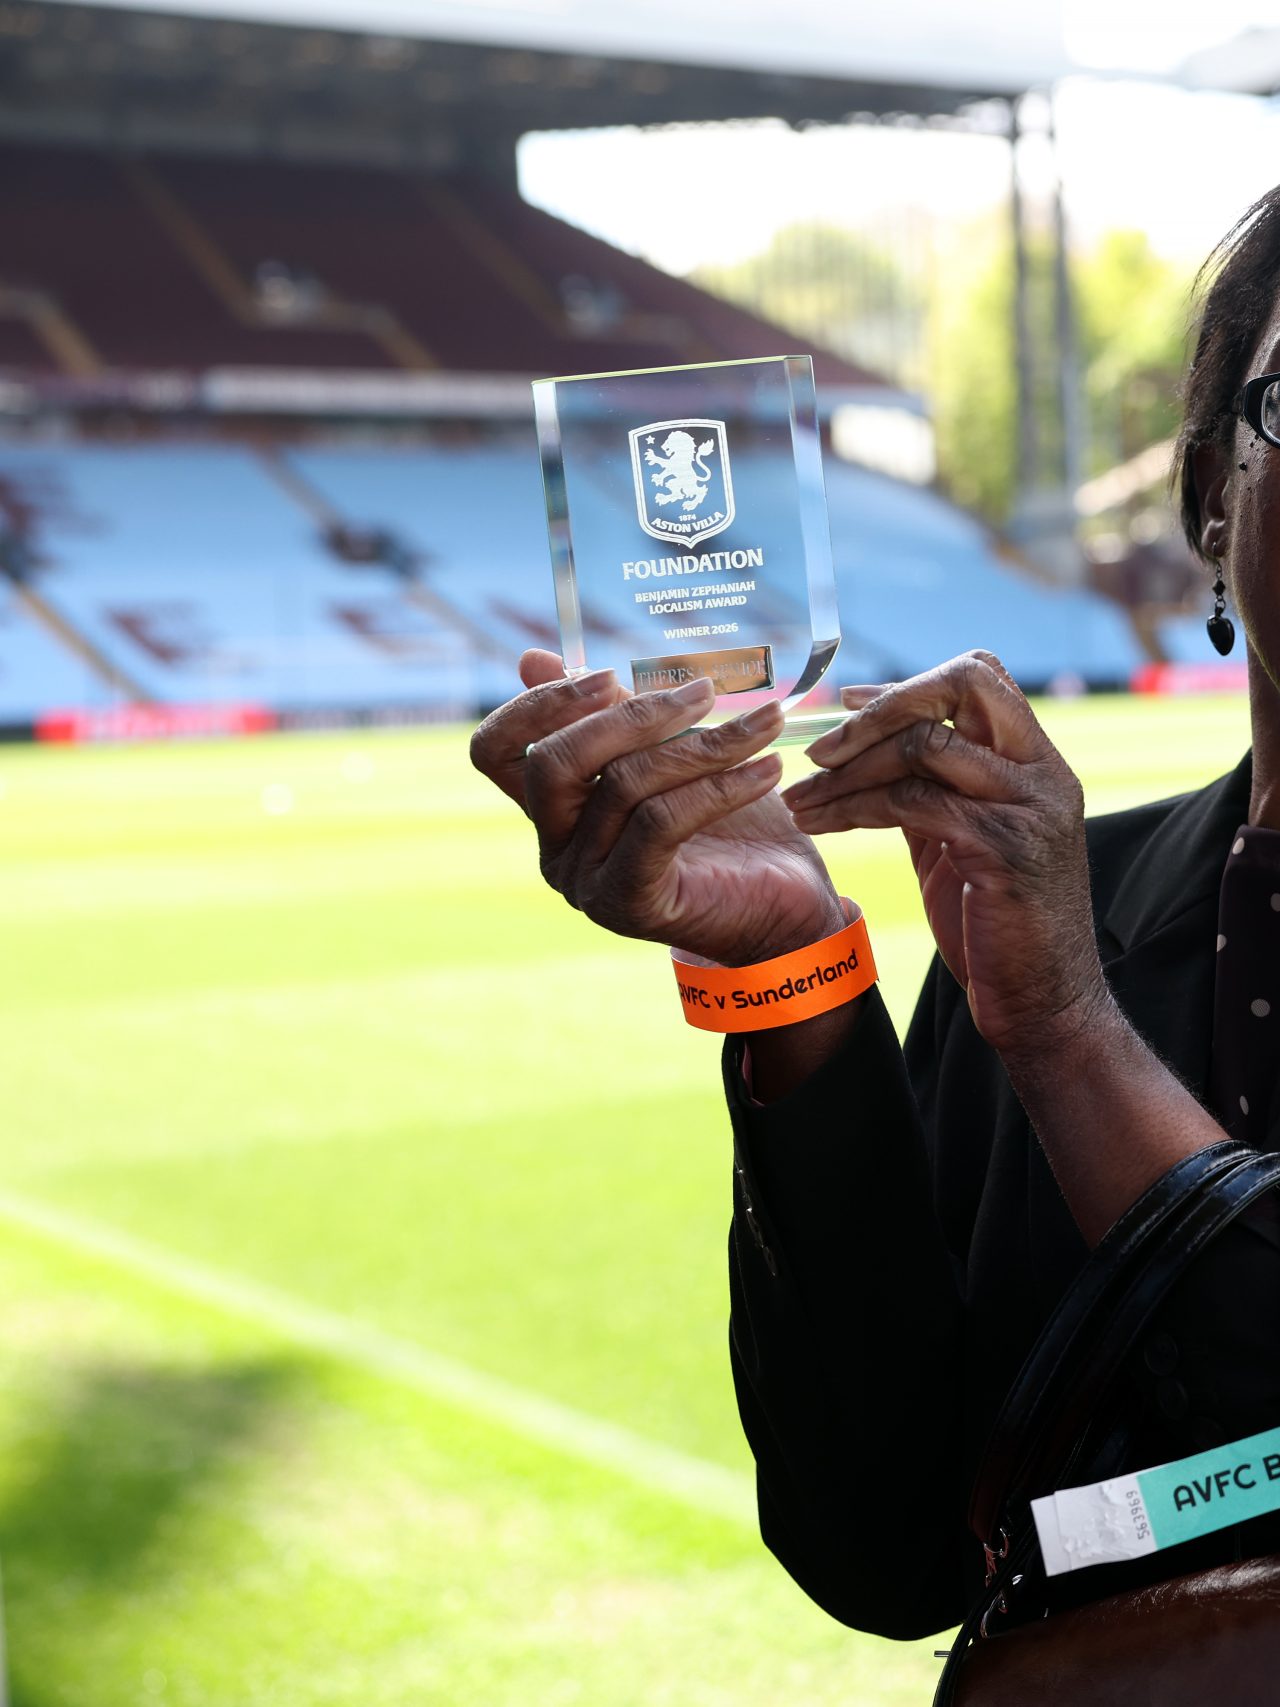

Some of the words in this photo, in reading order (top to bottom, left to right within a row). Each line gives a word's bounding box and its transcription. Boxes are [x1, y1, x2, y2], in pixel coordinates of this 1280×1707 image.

[651, 517, 692, 533] ASTON
[692, 511, 726, 532] VILLA
[678, 513, 697, 522] 1874
[622, 548, 764, 580] FOUNDATION
[634, 588, 690, 603] BENJAMIN
[691, 580, 756, 598] ZEPHANIAH
[649, 599, 703, 615] LOCALISM
[704, 595, 748, 609] AWARD
[663, 625, 711, 640] WINNER
[711, 622, 739, 635] 2026
[713, 995, 726, 1010] v
[731, 948, 860, 1010] Sunderland
[1172, 1464, 1257, 1513] AVFC
[1126, 1489, 1151, 1540] 563969
